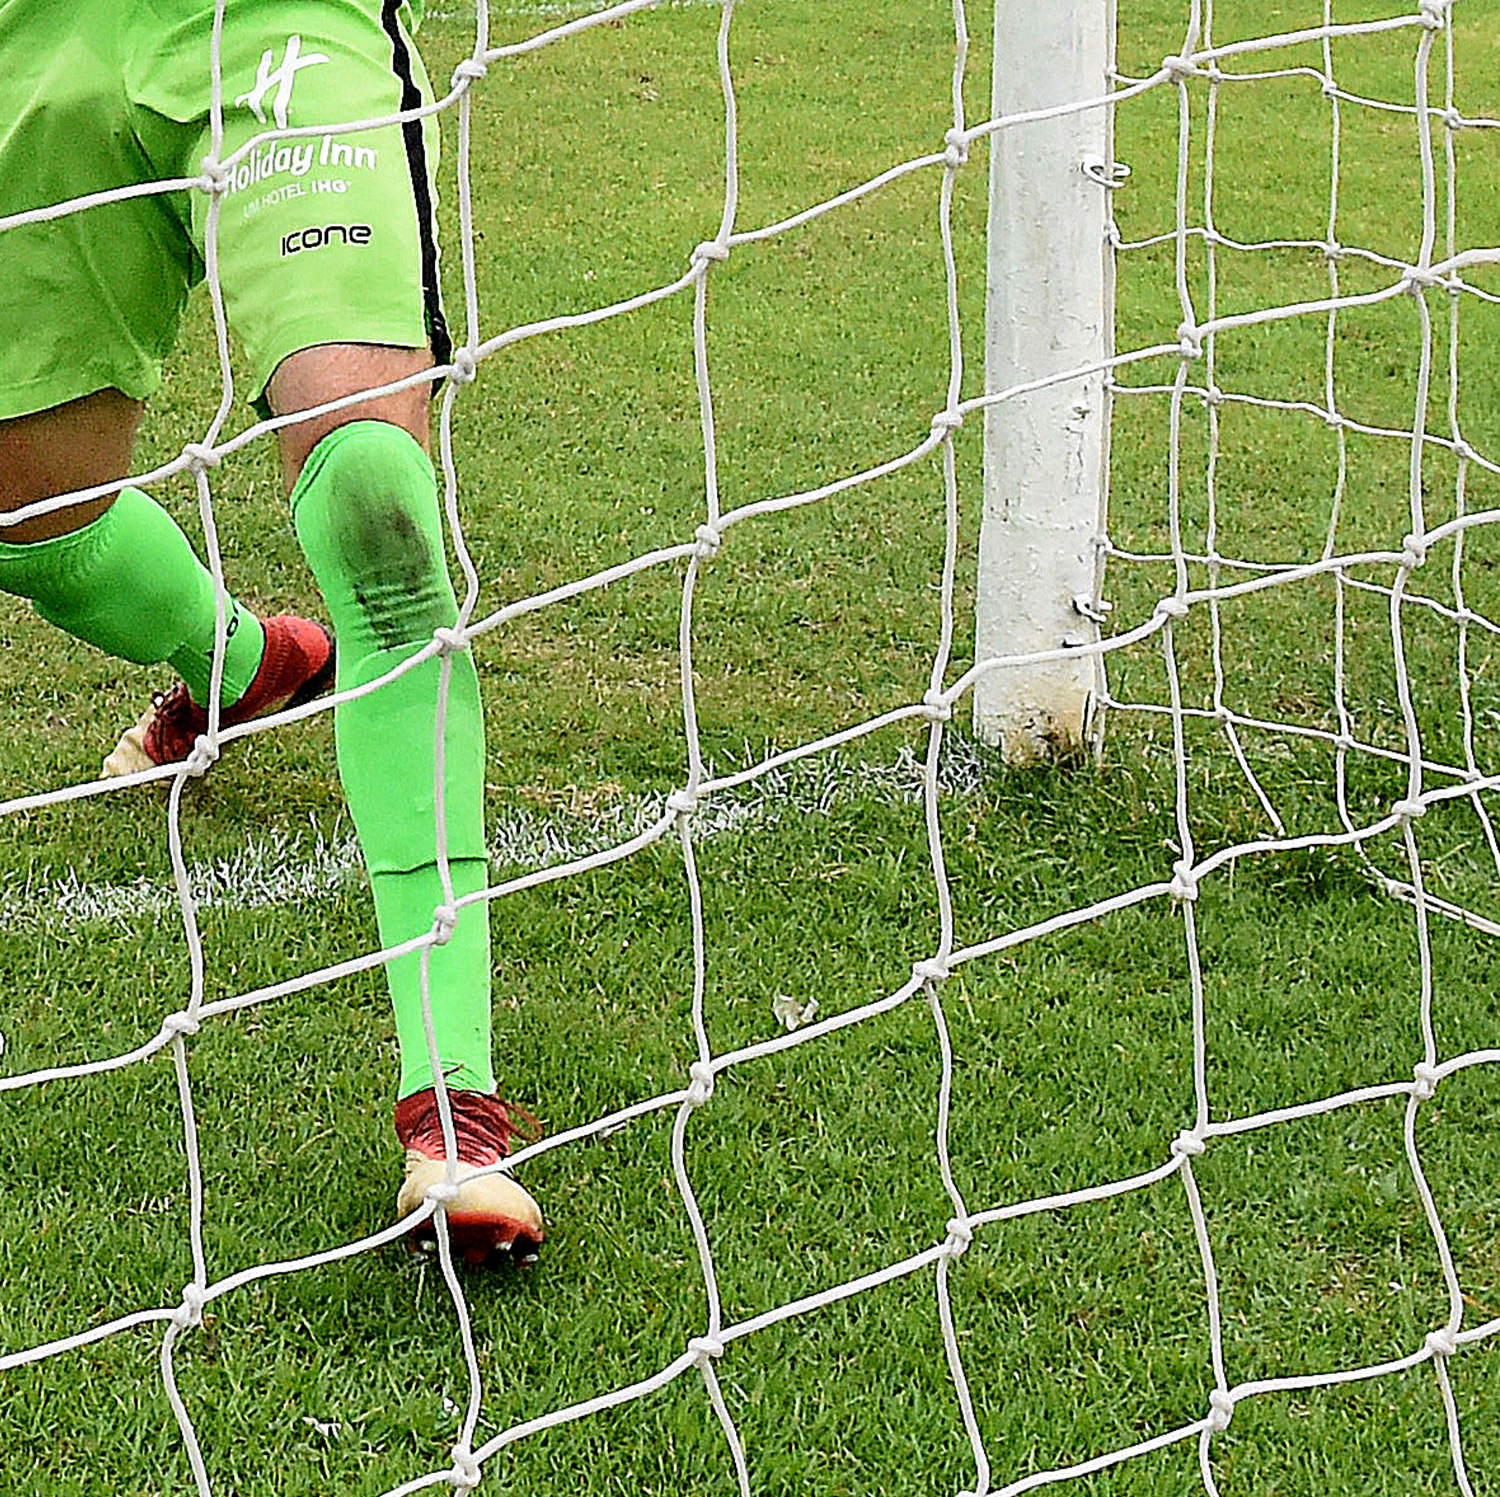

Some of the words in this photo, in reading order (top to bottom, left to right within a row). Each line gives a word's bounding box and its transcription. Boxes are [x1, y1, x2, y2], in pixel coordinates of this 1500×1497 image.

[319, 135, 377, 170] Inn
[262, 182, 306, 206] HOTEL
[311, 180, 347, 194] IHG
